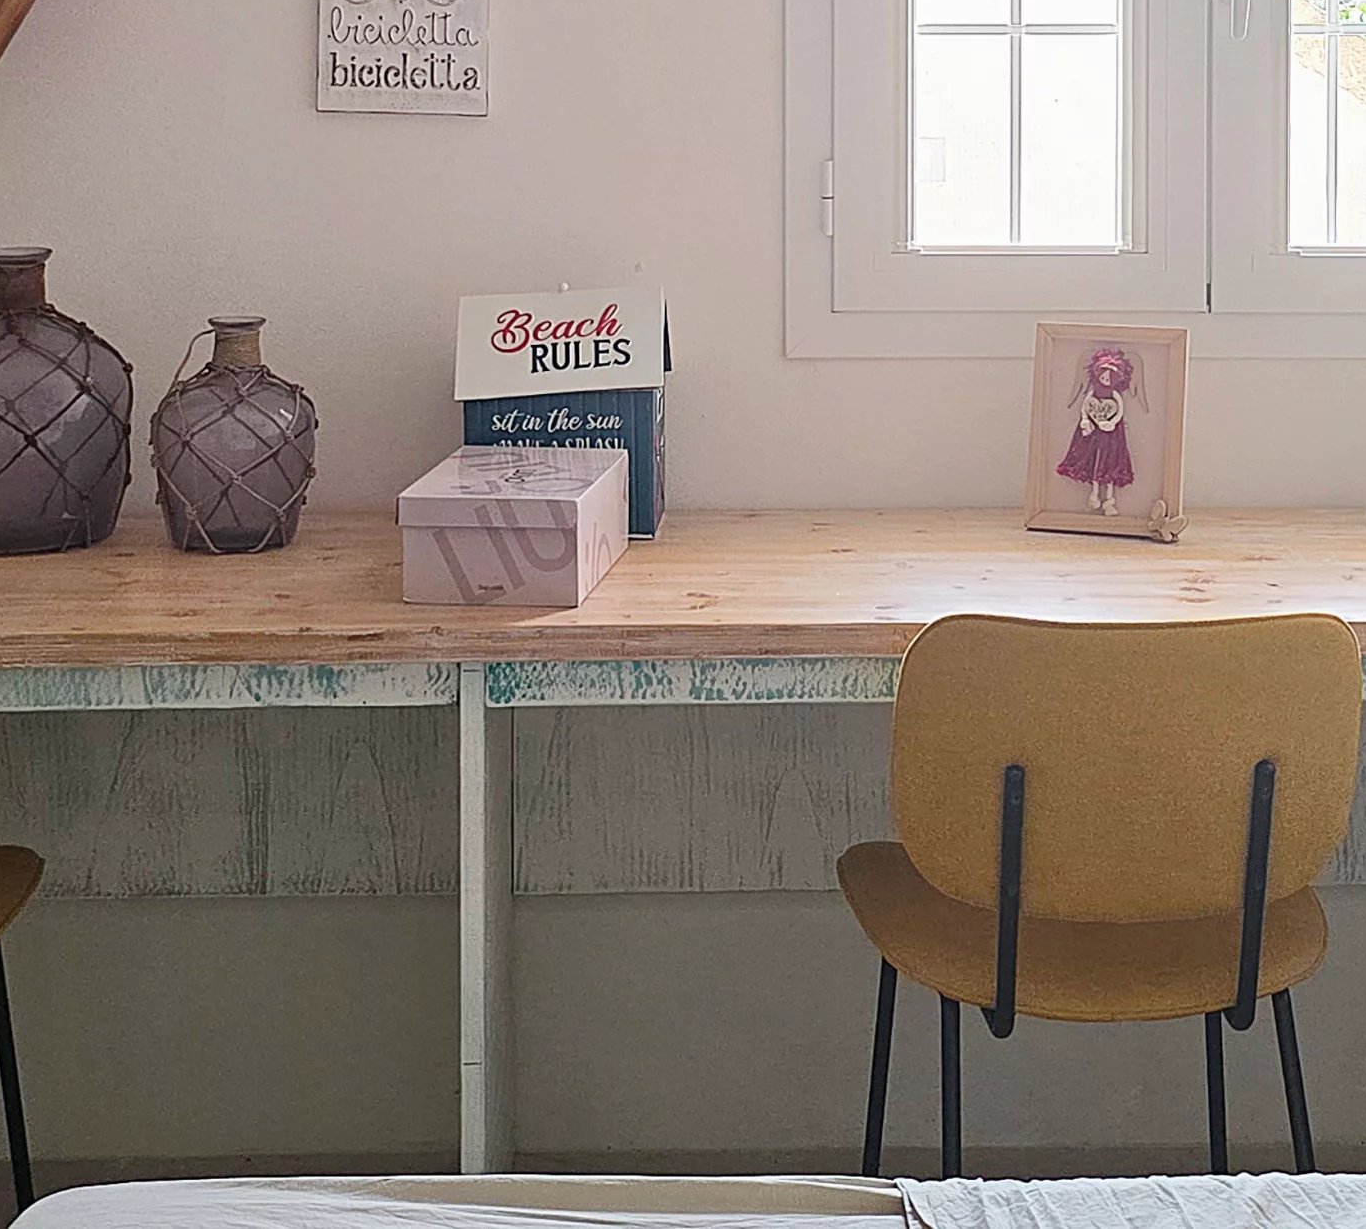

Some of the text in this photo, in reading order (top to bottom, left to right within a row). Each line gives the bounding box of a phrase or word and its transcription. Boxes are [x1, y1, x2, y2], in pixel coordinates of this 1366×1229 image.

[328, 6, 479, 47] bicicletta
[329, 52, 480, 91] bicicletta
[491, 303, 623, 353] Beach
[530, 338, 632, 374] RULES
[492, 408, 623, 433] sit in the sun
